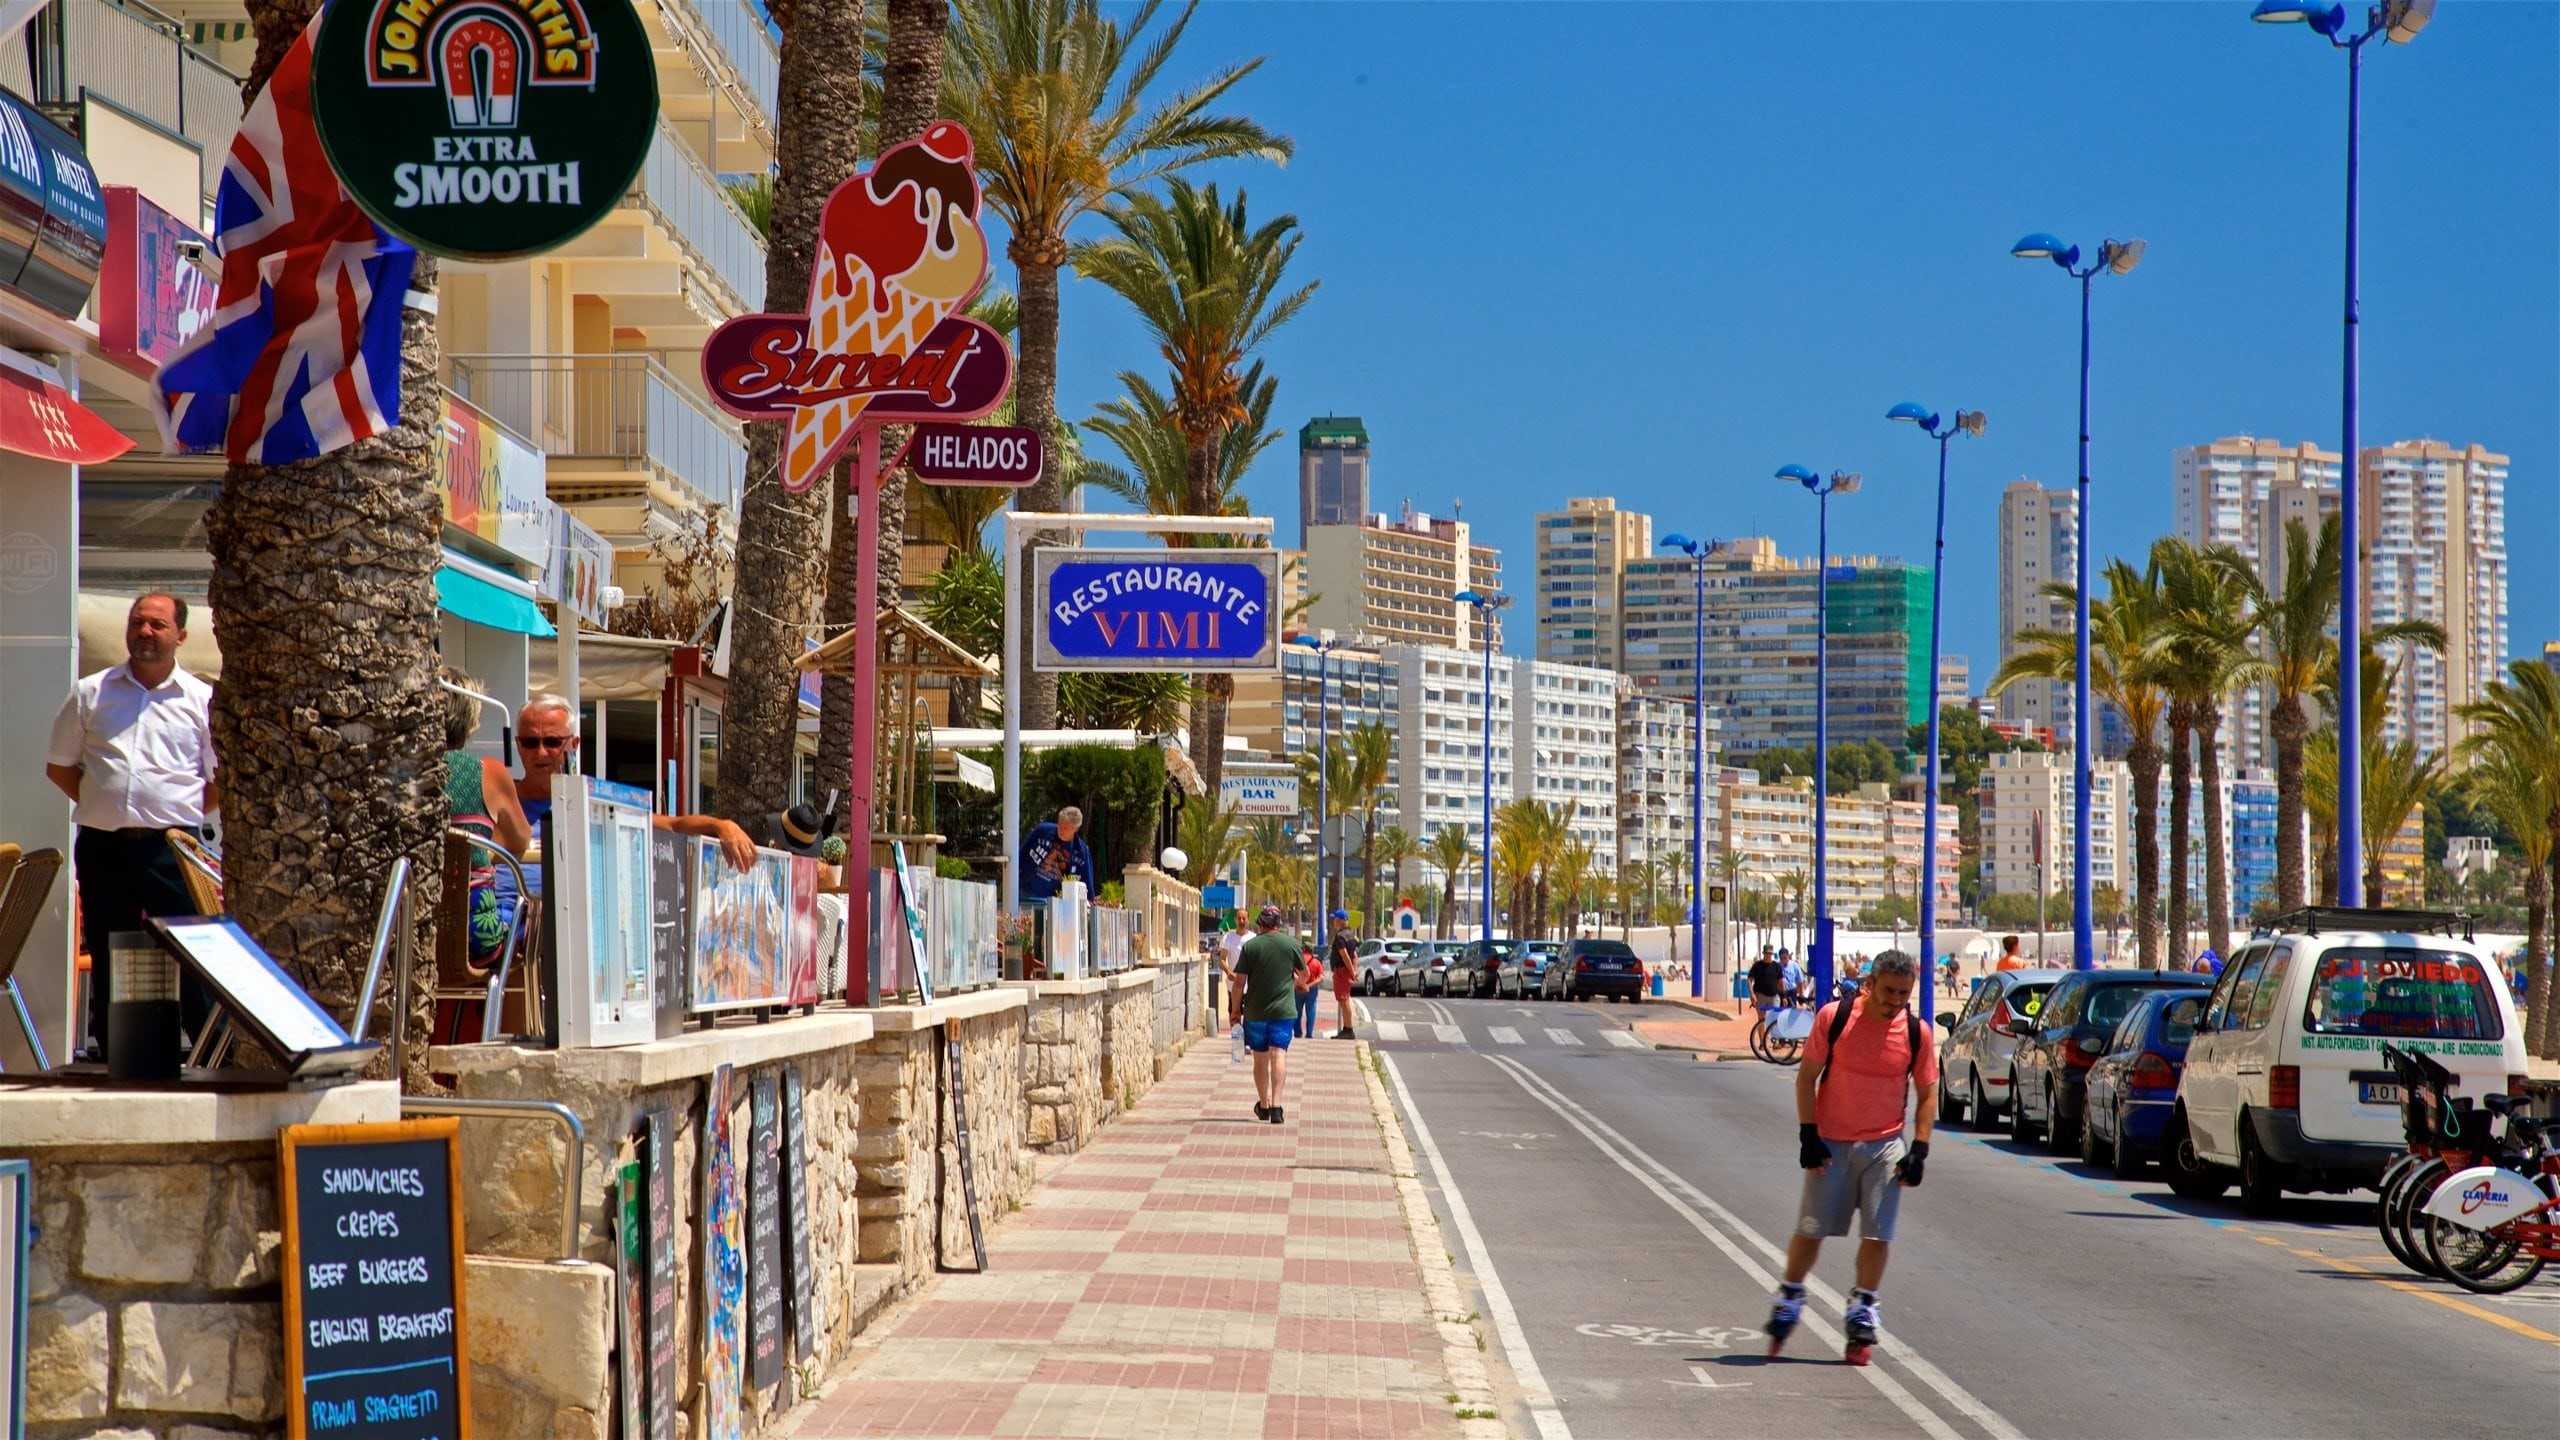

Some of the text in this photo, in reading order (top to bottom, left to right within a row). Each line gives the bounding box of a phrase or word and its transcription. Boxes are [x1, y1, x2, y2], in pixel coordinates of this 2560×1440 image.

[381, 0, 442, 74] JOH
[452, 30, 510, 69] ESTB 1758
[433, 136, 537, 162] EXTRA
[51, 148, 95, 202] AMSTEL
[393, 160, 582, 208] SMOOTH
[51, 189, 104, 230] PREMIUM QUALITY
[720, 327, 981, 407] Sirvent
[924, 435, 1029, 471] HELADOS
[505, 485, 543, 528] Lounge Bar
[1054, 566, 1261, 626] RESTAURANTE
[1091, 611, 1222, 649] VIMI
[1221, 777, 1297, 791] RESTAURANTE
[1242, 789, 1275, 799] BAR
[1245, 804, 1291, 812] CHIQUITOS
[2379, 961, 2480, 985] OVIEDO
[2442, 1042, 2456, 1055] AIRE
[2459, 1043, 2504, 1056] ACONDICIONADO
[322, 1167, 425, 1197] SANDWICHES
[2463, 1190, 2509, 1203] CLAVERIA
[336, 1209, 400, 1238] CREPES
[308, 1256, 429, 1290] BEEF BURGERS
[309, 1307, 454, 1348] ENGLISH BREAKFAST
[311, 1399, 357, 1430] PRAWN
